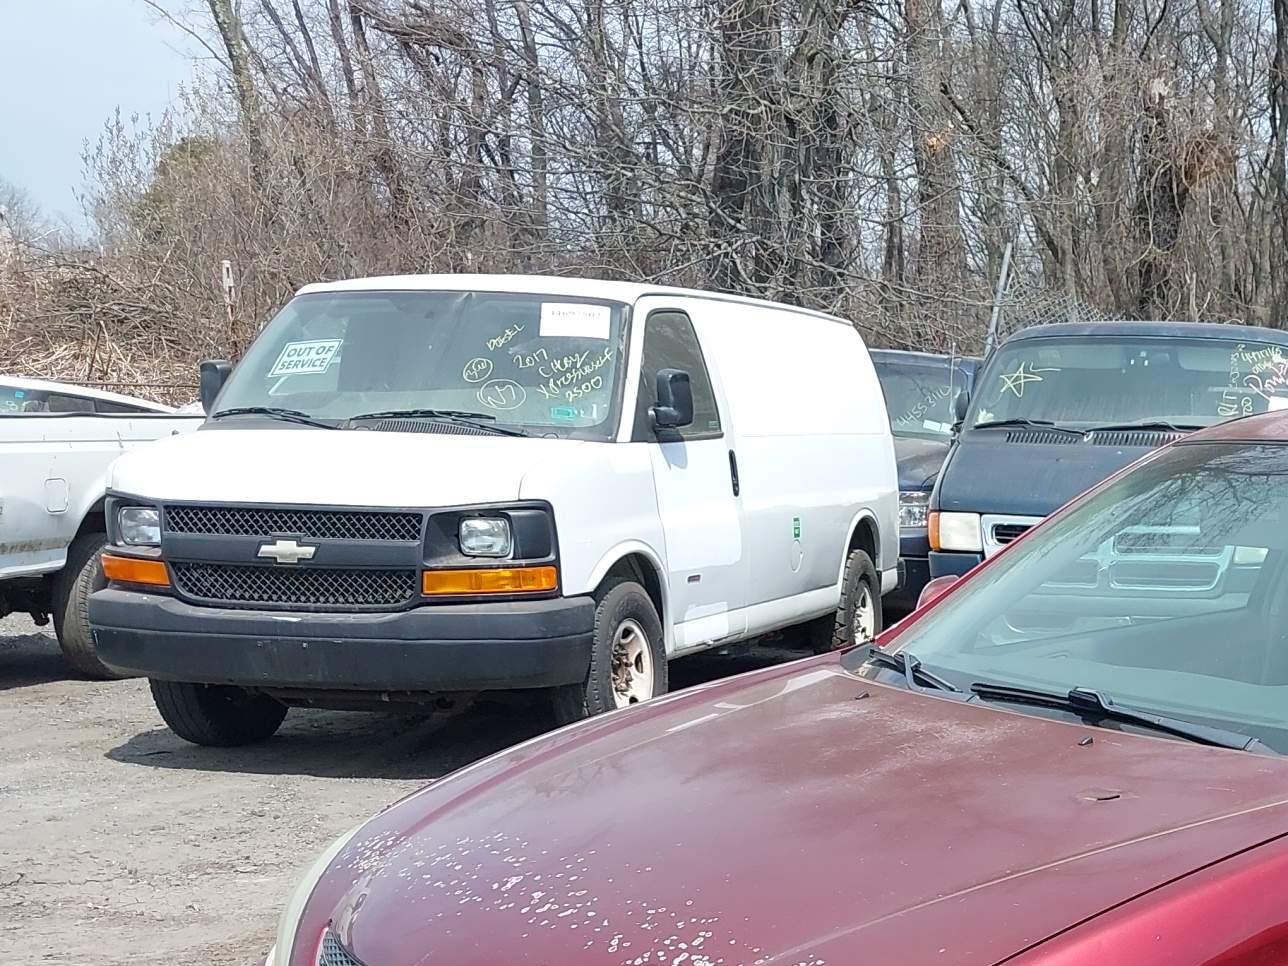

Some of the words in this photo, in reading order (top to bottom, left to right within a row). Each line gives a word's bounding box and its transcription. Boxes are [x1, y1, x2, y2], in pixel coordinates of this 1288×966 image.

[286, 346, 315, 358] OUT
[315, 345, 336, 356] OF
[278, 357, 328, 370] SERVICE
[512, 348, 549, 369] 2017
